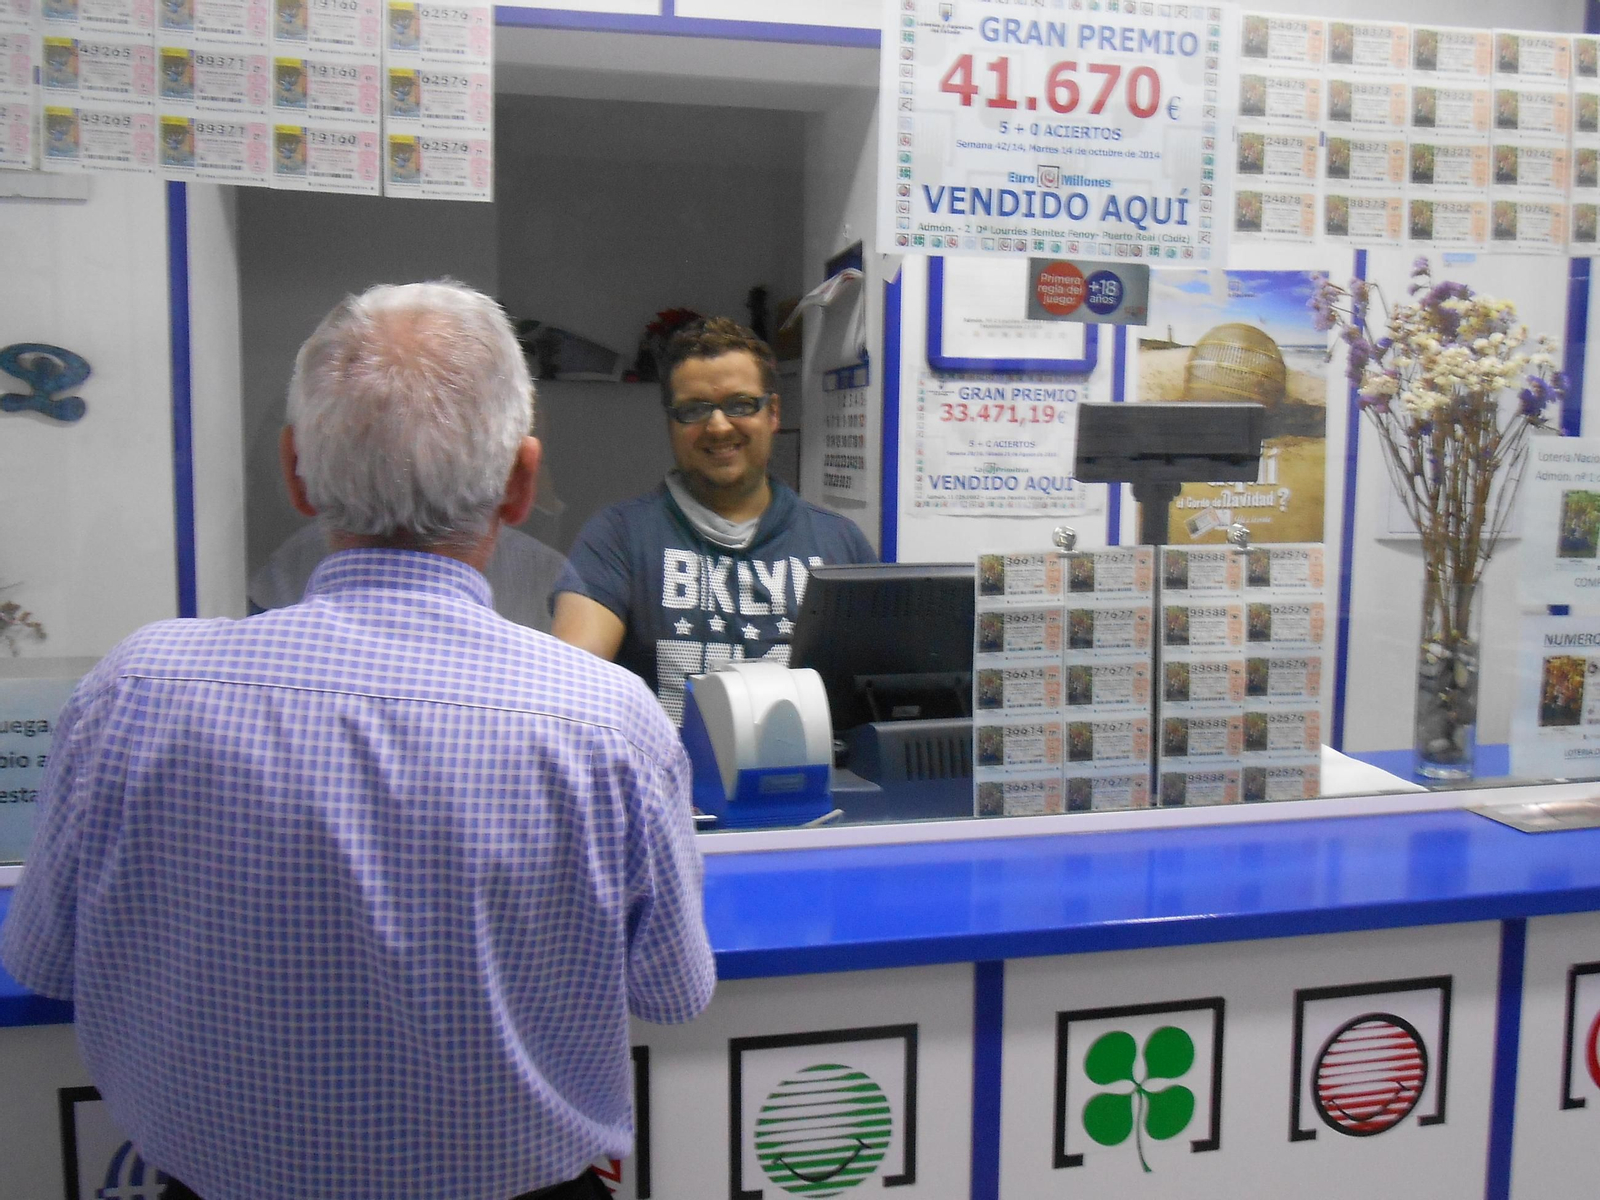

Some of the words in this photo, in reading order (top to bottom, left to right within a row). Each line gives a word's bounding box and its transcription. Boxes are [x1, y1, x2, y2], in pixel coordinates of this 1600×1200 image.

[979, 16, 1066, 48] GRAN
[1077, 24, 1200, 57] PREMIO
[939, 53, 1162, 119] 41.670
[1166, 95, 1182, 121] €
[999, 121, 1008, 135] 5
[1014, 123, 1024, 134] +
[1030, 123, 1039, 137] 0
[1043, 124, 1122, 141] ACIERTOS
[956, 139, 993, 151] Semana
[1029, 143, 1058, 155] Martes
[1061, 145, 1073, 156] 14
[1075, 146, 1085, 157] de
[1087, 147, 1123, 159] octubre
[1124, 149, 1136, 160] de
[1138, 150, 1161, 161] 2014
[1008, 171, 1035, 185] Euro
[1061, 174, 1111, 188] Millones
[923, 184, 1089, 221] VENDIDO
[1101, 188, 1190, 231] AQUÍ
[964, 225, 971, 234] 2
[990, 226, 1028, 237] Lourdes
[1102, 231, 1133, 242] Puerto
[1135, 233, 1156, 243] Real
[1040, 273, 1082, 284] Primera
[1088, 279, 1117, 296] +18
[1037, 284, 1064, 295] regla
[1066, 284, 1083, 294] del
[958, 386, 1005, 401] GRAN
[1011, 387, 1078, 402] PREMIO
[939, 402, 1055, 427] 33.471,19
[1057, 410, 1068, 424] €
[993, 440, 1036, 448] ACIERTOS
[928, 474, 1018, 491] VENDIDO
[1024, 471, 1074, 494] AQUÍ
[1186, 497, 1211, 508] Gordo
